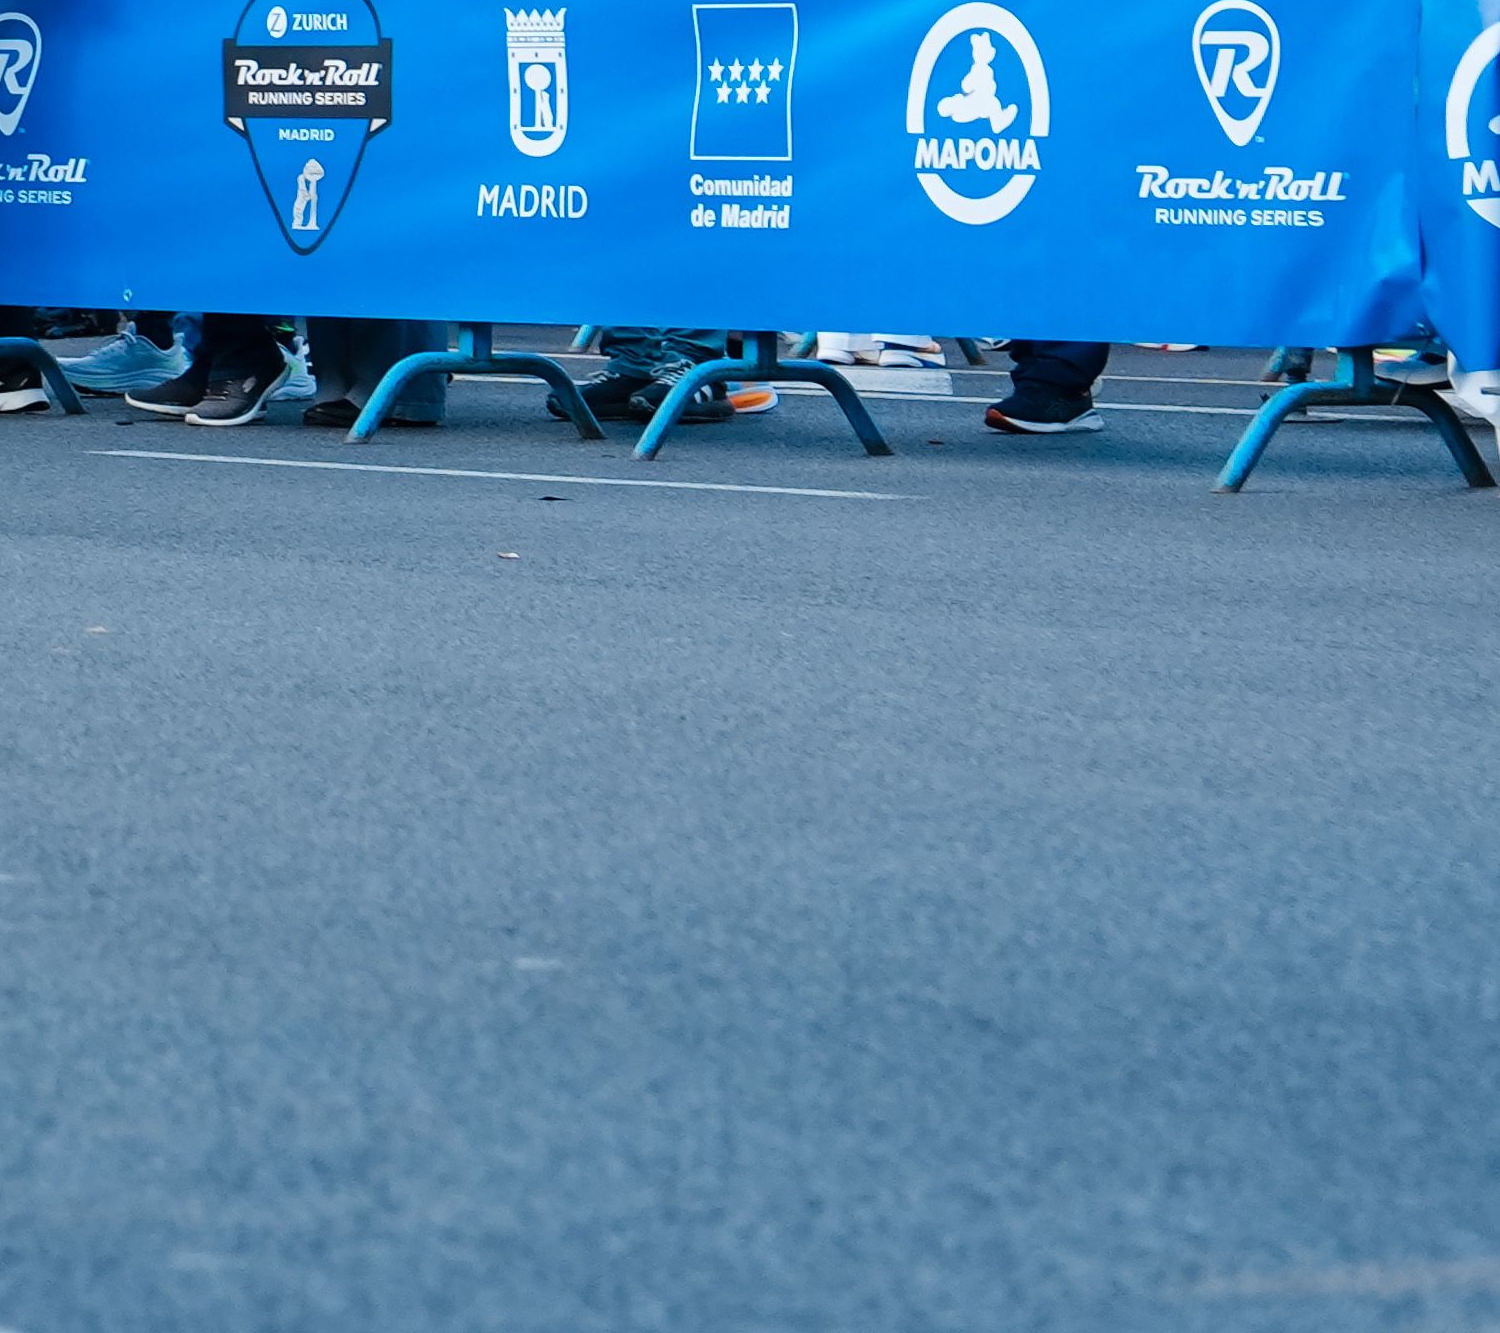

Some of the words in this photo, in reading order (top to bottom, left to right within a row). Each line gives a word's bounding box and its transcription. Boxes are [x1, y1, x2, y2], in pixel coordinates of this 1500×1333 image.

[291, 12, 348, 32] ZURICH
[247, 91, 314, 106] RUNNING
[314, 91, 367, 107] SERIES
[278, 128, 335, 142] MADRID
[914, 136, 1042, 171] MAPOMA
[689, 173, 793, 199] Comunidad
[16, 189, 73, 206] SERIES
[476, 184, 588, 220] MADRID
[690, 203, 717, 228] de
[720, 204, 791, 230] Madrid
[1154, 207, 1247, 226] RUNNING
[1249, 208, 1325, 228] SERIES
